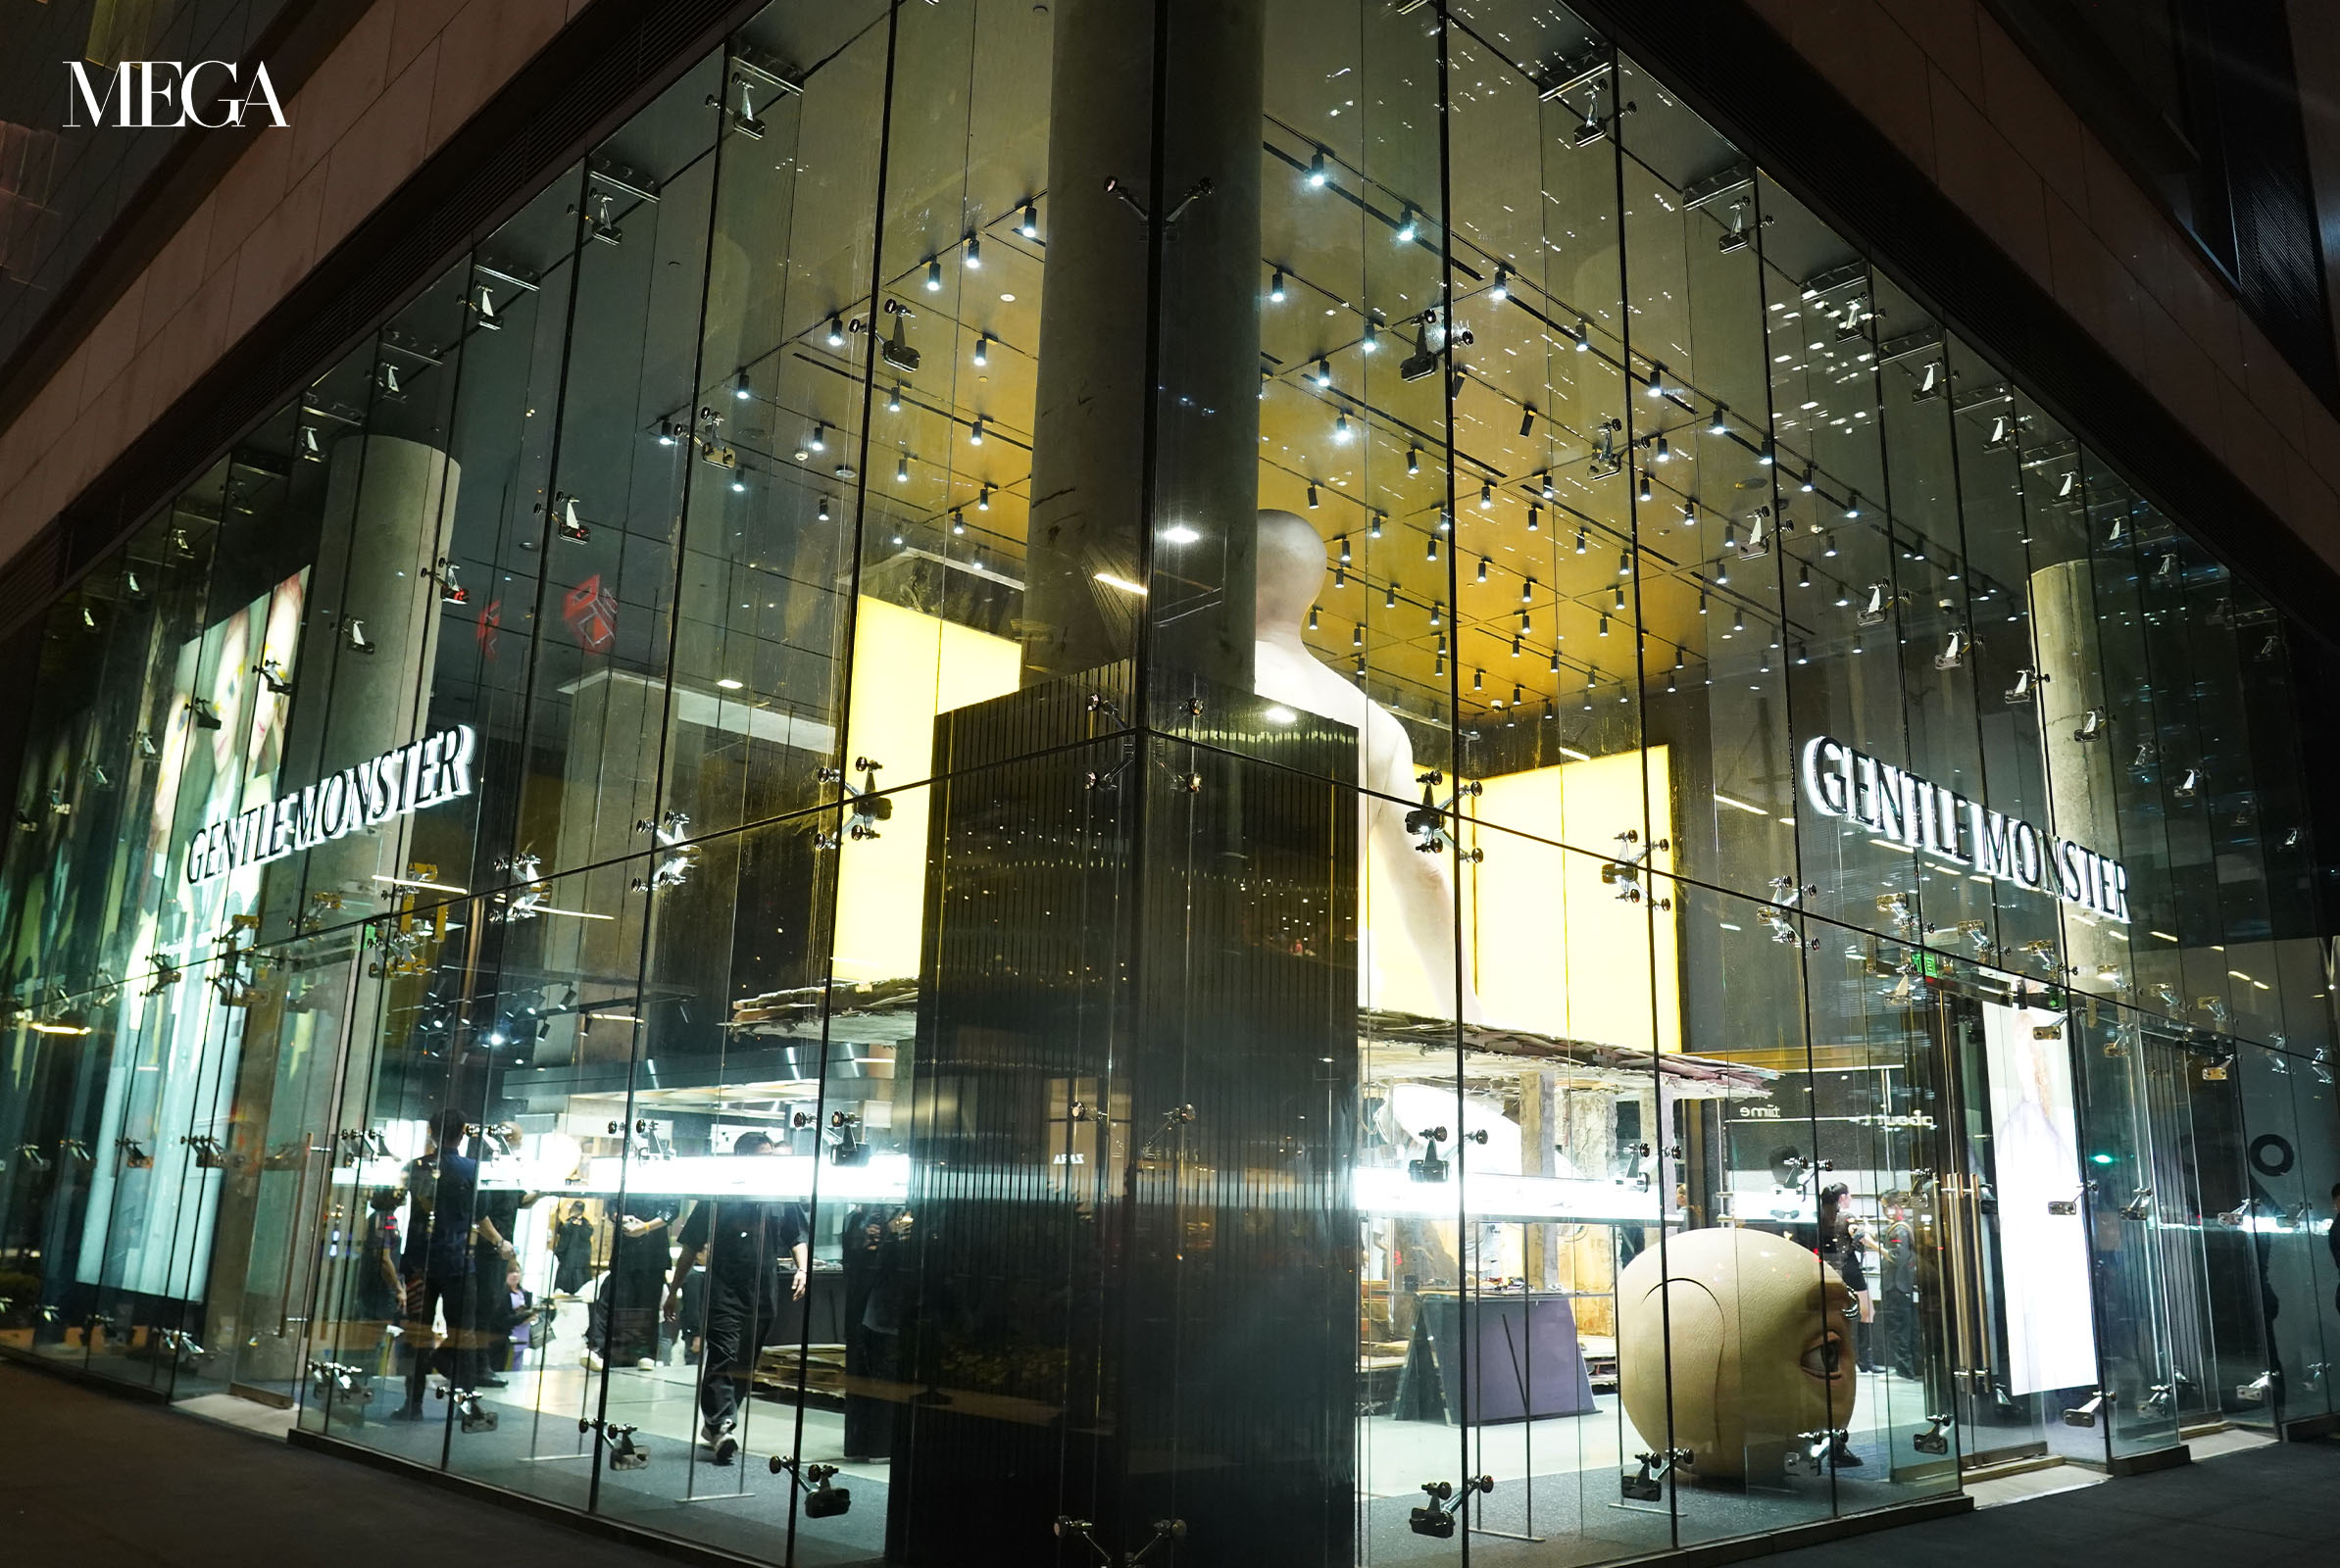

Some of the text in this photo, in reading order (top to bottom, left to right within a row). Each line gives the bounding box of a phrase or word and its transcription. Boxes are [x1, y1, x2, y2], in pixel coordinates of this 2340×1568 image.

[186, 724, 475, 886] GENTLE MONSTER
[1803, 735, 2132, 924] GENTLE MONSTER
